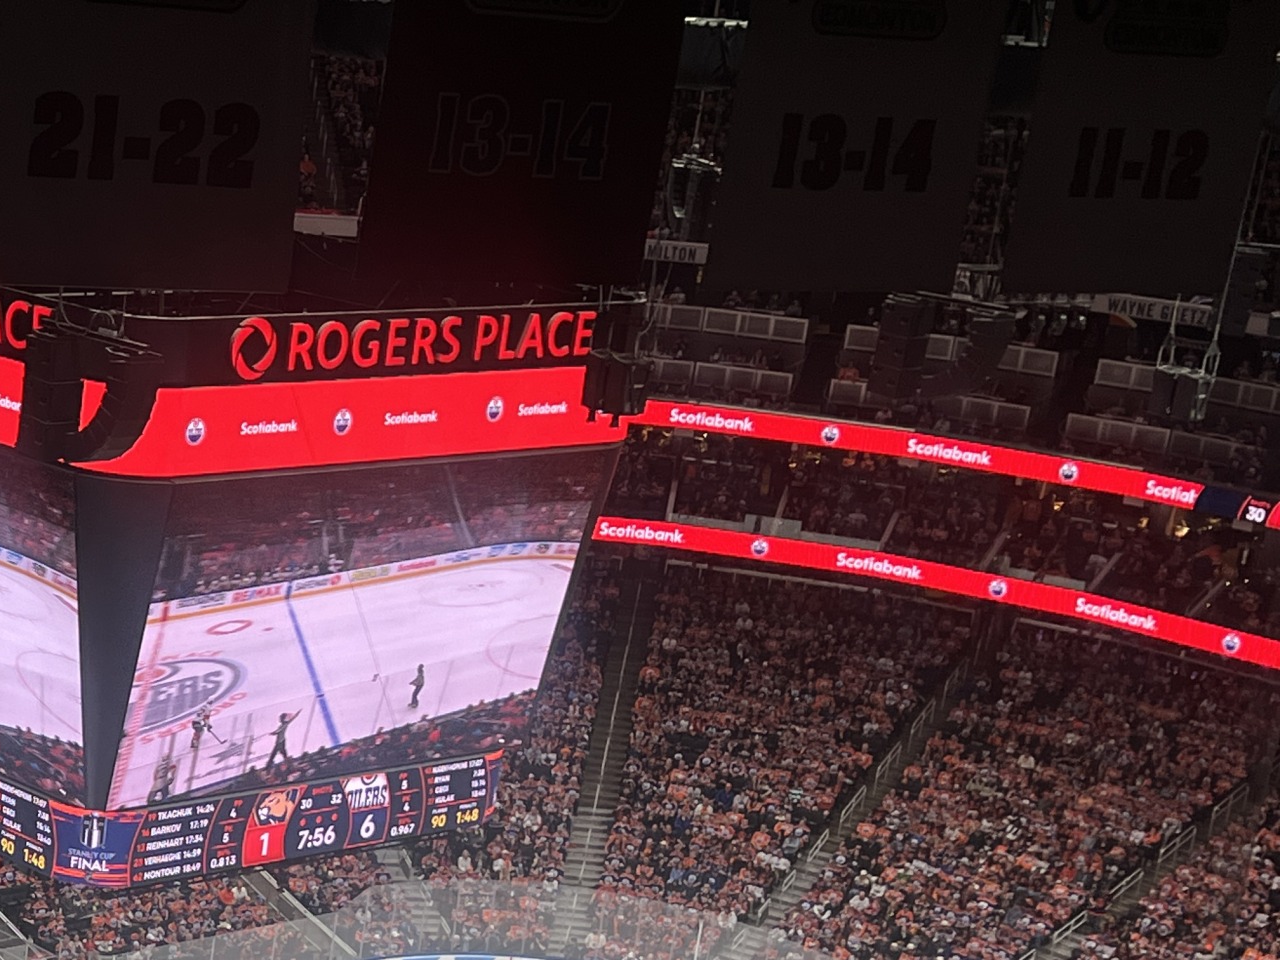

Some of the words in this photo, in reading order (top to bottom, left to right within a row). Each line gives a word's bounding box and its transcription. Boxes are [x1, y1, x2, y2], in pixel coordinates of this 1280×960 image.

[26, 90, 261, 189] 21-22
[427, 91, 613, 181] 13-14
[771, 112, 937, 193] 13-14
[1068, 125, 1210, 201] 11-12
[1108, 298, 1156, 318] WAYNE
[288, 316, 463, 371] ROGERS
[474, 311, 597, 361] PLACE
[384, 410, 438, 427] Scotiabank
[518, 401, 568, 417] Scotiabank
[240, 419, 298, 436] Scotiabank
[670, 408, 753, 431] Scotiabank
[907, 439, 990, 465] Scotiabank
[1246, 506, 1266, 523] 30
[599, 522, 684, 543] Scotiabank
[836, 552, 921, 580] Scotiabank
[1075, 597, 1156, 630] Scotiabank
[401, 780, 408, 790] 5
[300, 798, 313, 809] 30
[330, 793, 342, 805] 32
[347, 785, 387, 809] OILERS
[403, 802, 410, 811] 4
[157, 807, 193, 820] TKACHUK
[230, 808, 237, 818] 4
[431, 814, 447, 829] 90
[456, 808, 479, 824] 1:48
[150, 823, 182, 837] BARKOV
[360, 814, 375, 838] 6
[390, 823, 416, 837] 0.967
[222, 832, 230, 843] 5
[260, 832, 269, 857] 1
[297, 825, 336, 850] 7:56
[0, 837, 15, 855] 90
[23, 848, 46, 870] 1:48
[99, 851, 116, 861] CUP
[210, 855, 237, 869] 0.813
[70, 856, 110, 872] FINAL
[143, 866, 181, 880] MONTOUR
